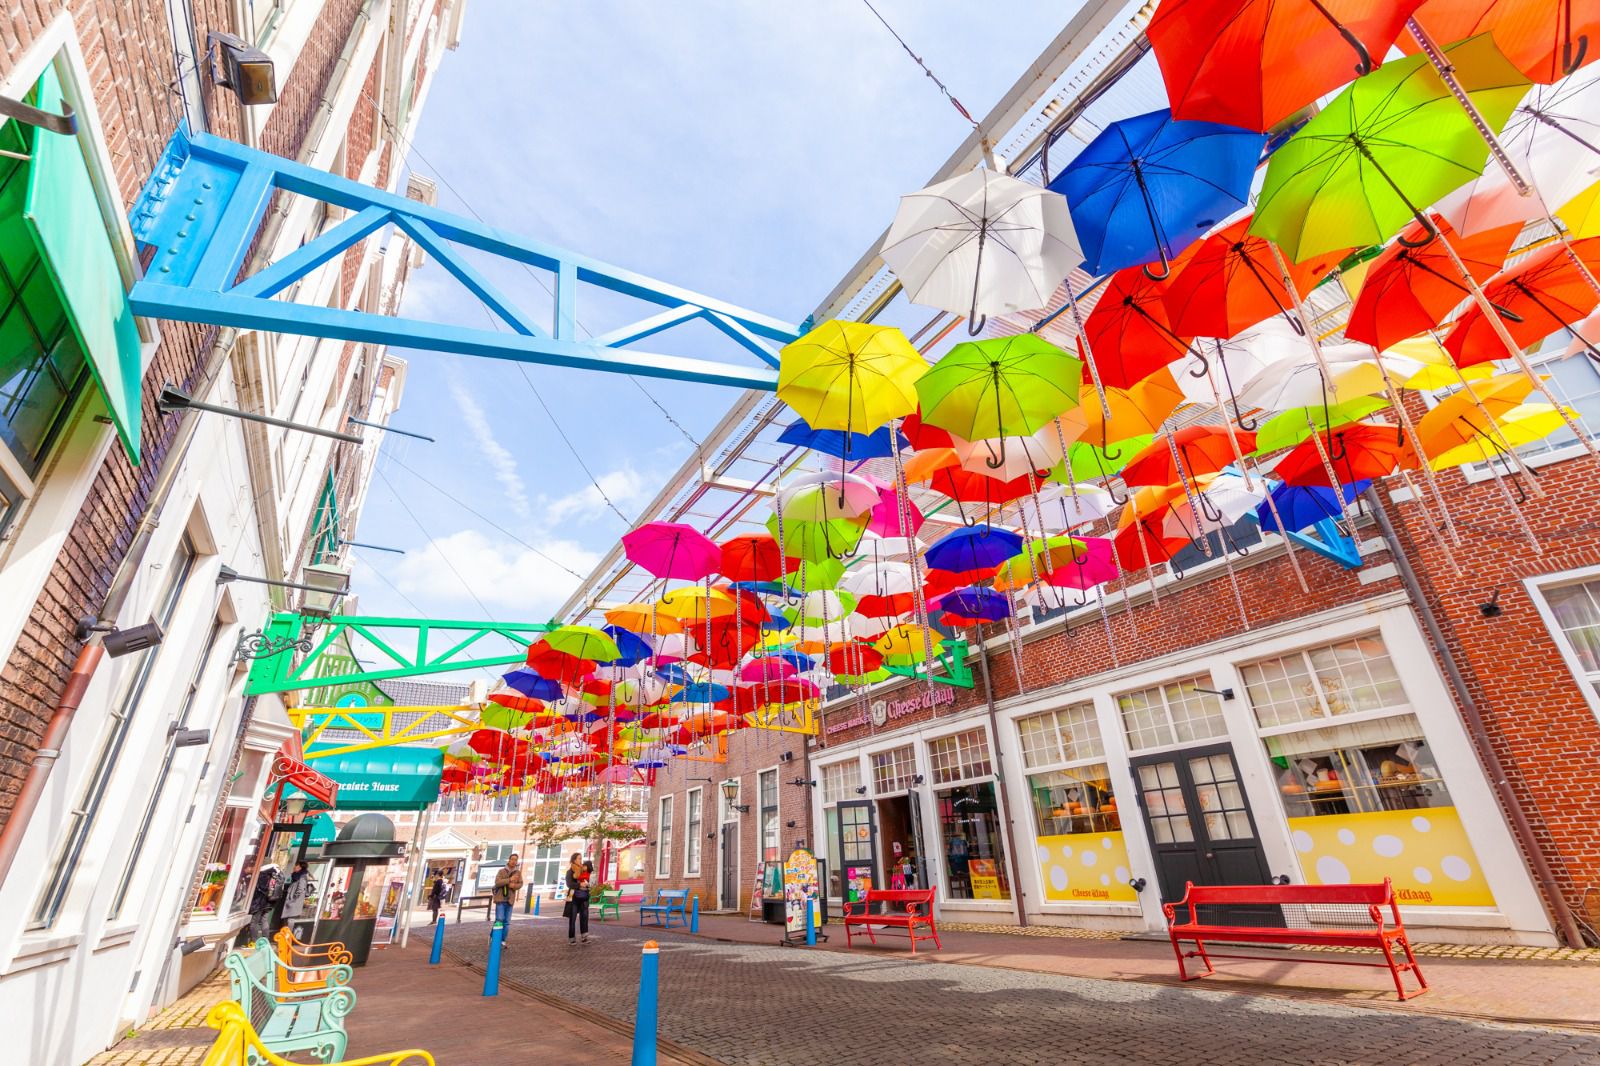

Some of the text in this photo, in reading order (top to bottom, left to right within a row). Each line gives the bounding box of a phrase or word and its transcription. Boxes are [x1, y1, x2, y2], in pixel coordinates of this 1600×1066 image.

[887, 696, 921, 719] Cheese
[826, 721, 848, 735] CHEESE
[338, 781, 400, 792] ocolate House
